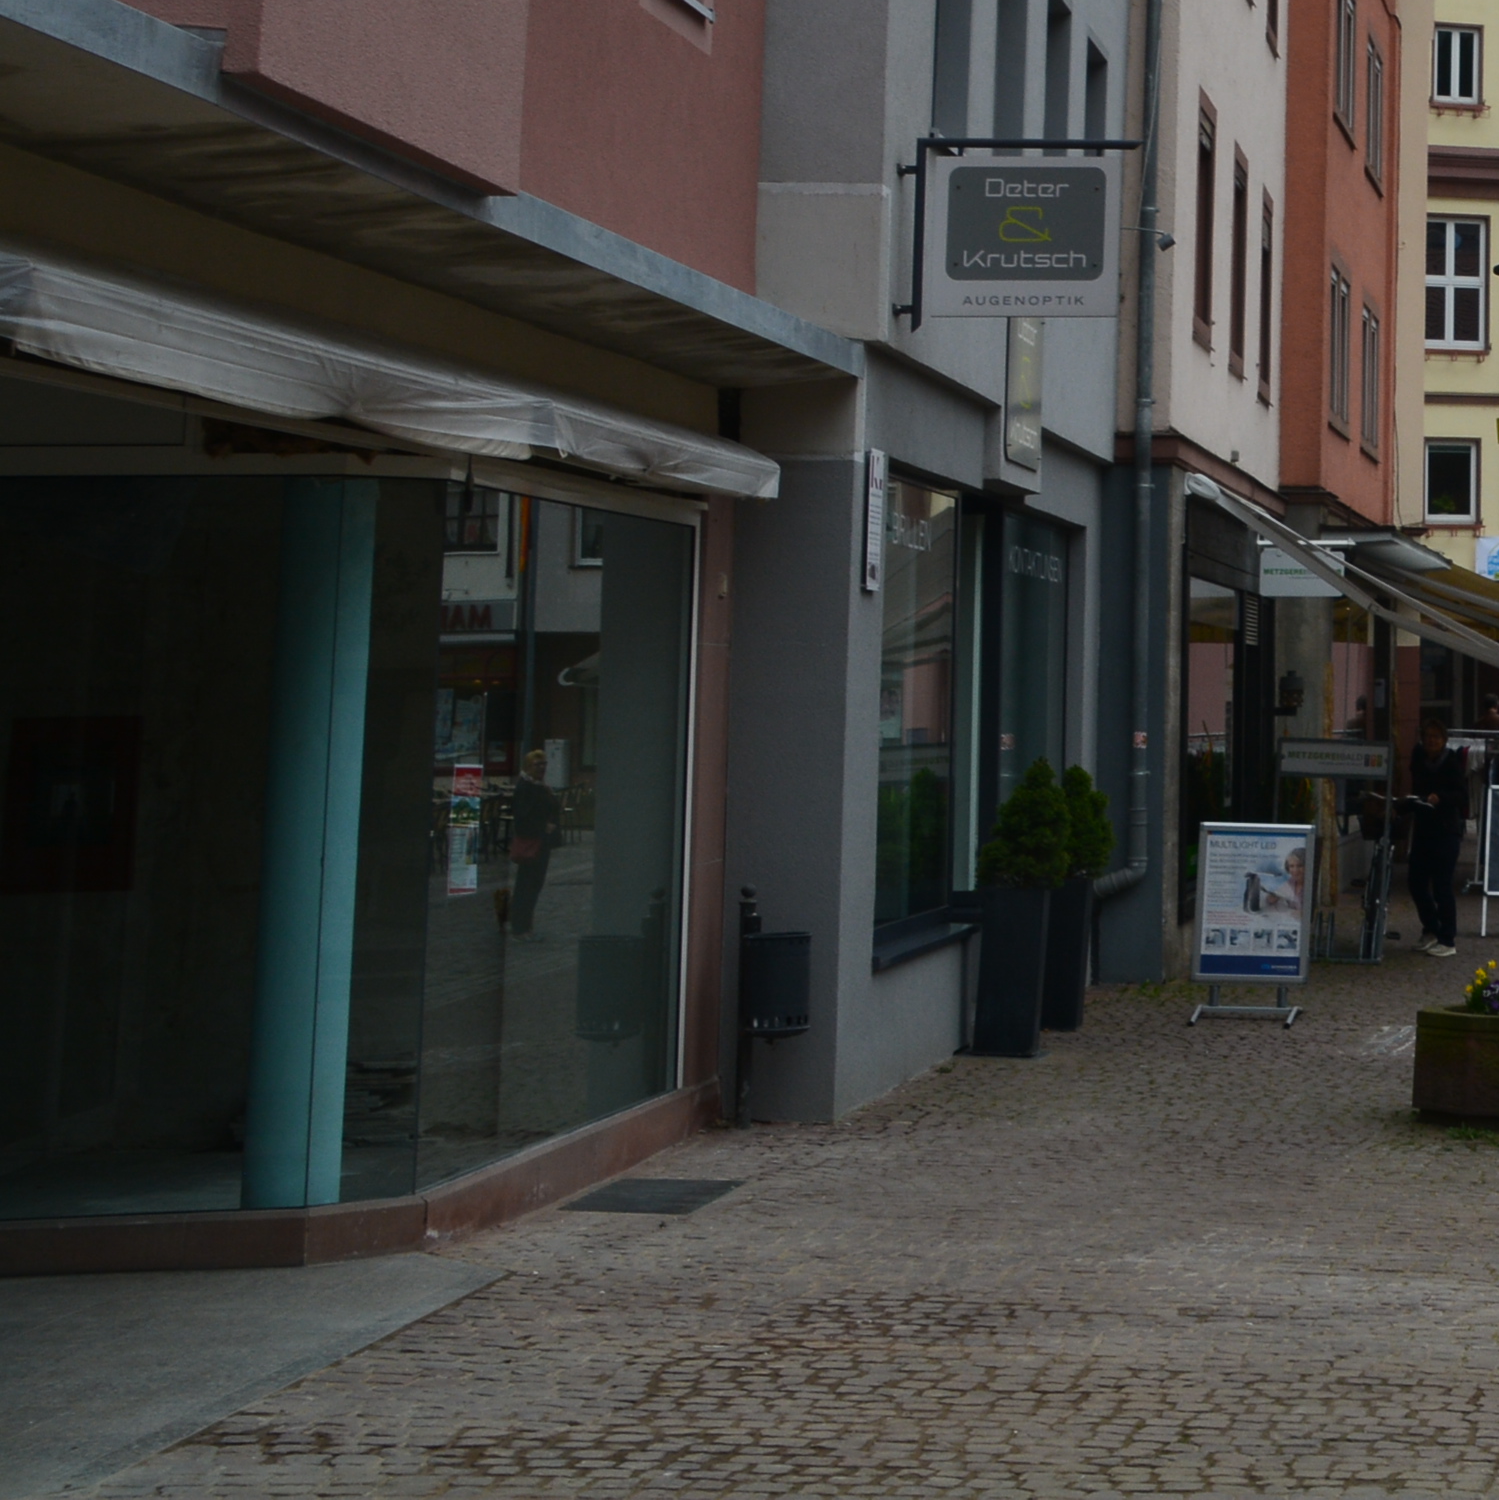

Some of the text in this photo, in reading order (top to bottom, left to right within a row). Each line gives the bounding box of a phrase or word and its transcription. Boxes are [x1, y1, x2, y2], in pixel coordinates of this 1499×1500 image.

[985, 178, 1070, 197] Deter
[963, 250, 1087, 268] Krutsch
[962, 295, 1085, 306] AUGENOPTIK
[1260, 841, 1277, 850] LED
